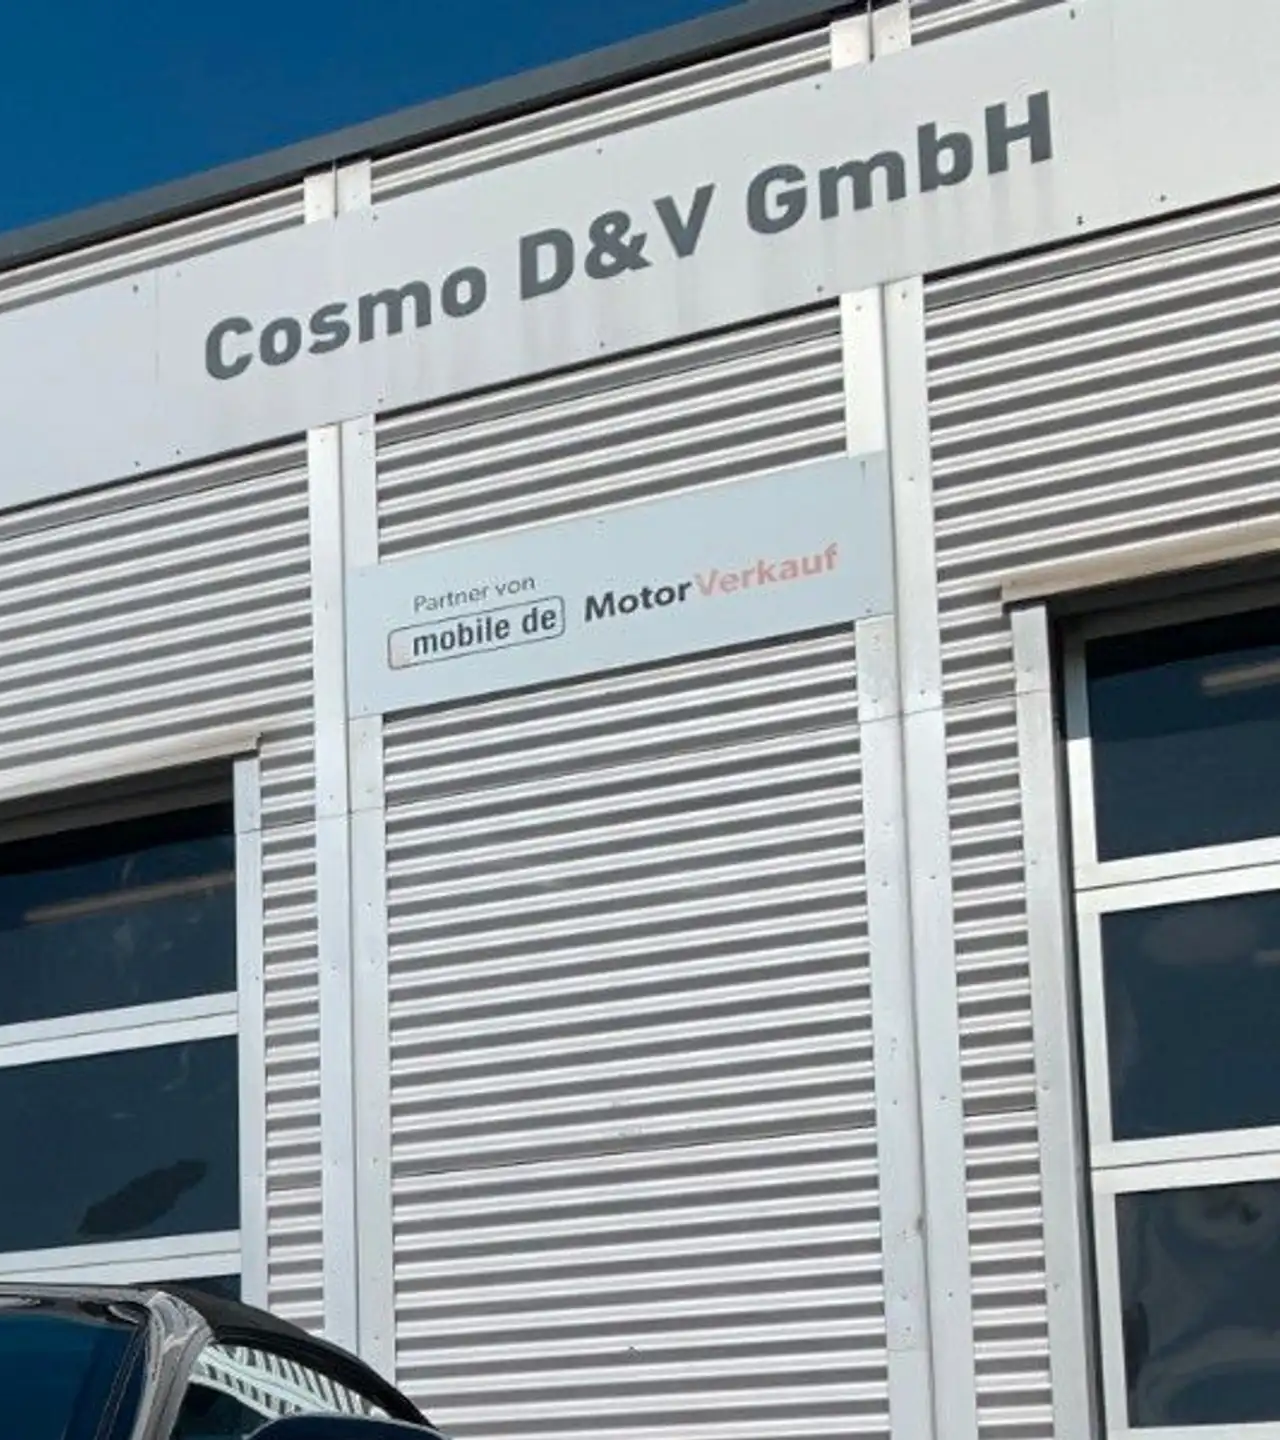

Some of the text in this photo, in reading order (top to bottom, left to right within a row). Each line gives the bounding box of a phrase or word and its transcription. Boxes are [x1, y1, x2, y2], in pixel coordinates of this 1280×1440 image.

[206, 90, 1054, 380] Cosmo D&V GmbH
[413, 575, 535, 614] Partner von
[412, 615, 511, 657] mobile
